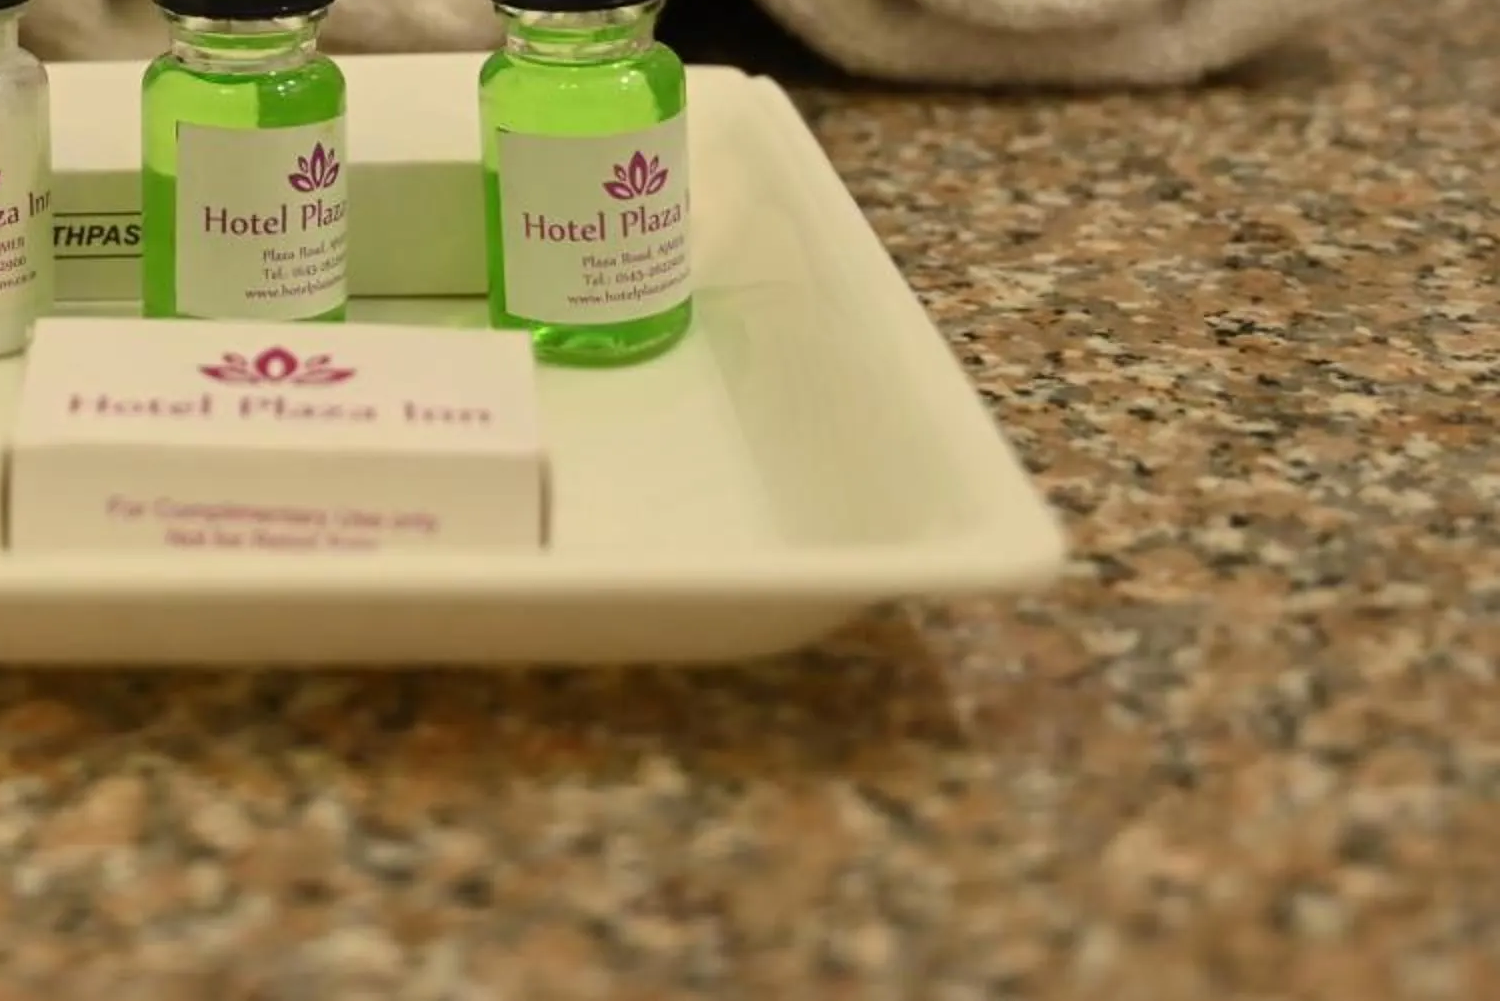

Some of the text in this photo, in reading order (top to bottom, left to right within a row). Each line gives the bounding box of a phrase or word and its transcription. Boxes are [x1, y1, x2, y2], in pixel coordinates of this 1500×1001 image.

[52, 222, 142, 248] THPAS
[203, 203, 288, 237] Hotel
[522, 205, 681, 242] Hotel Plaza
[68, 393, 492, 425] Hotel Plaza Inn
